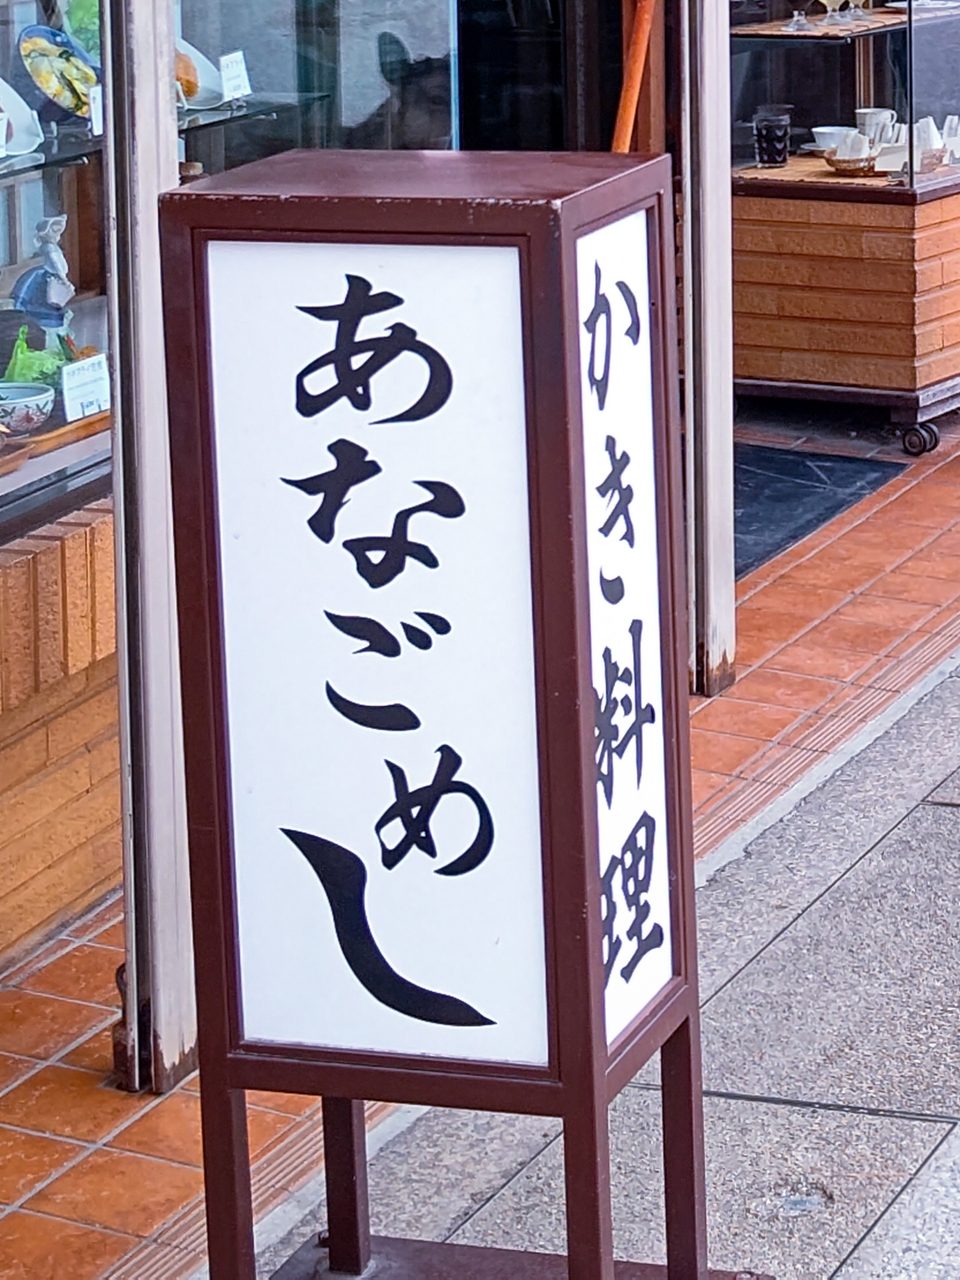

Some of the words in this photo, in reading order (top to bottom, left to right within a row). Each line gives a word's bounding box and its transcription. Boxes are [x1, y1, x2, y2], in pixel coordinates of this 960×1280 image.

[279, 273, 498, 1028] あなごめし
[585, 260, 667, 990] かき料理
